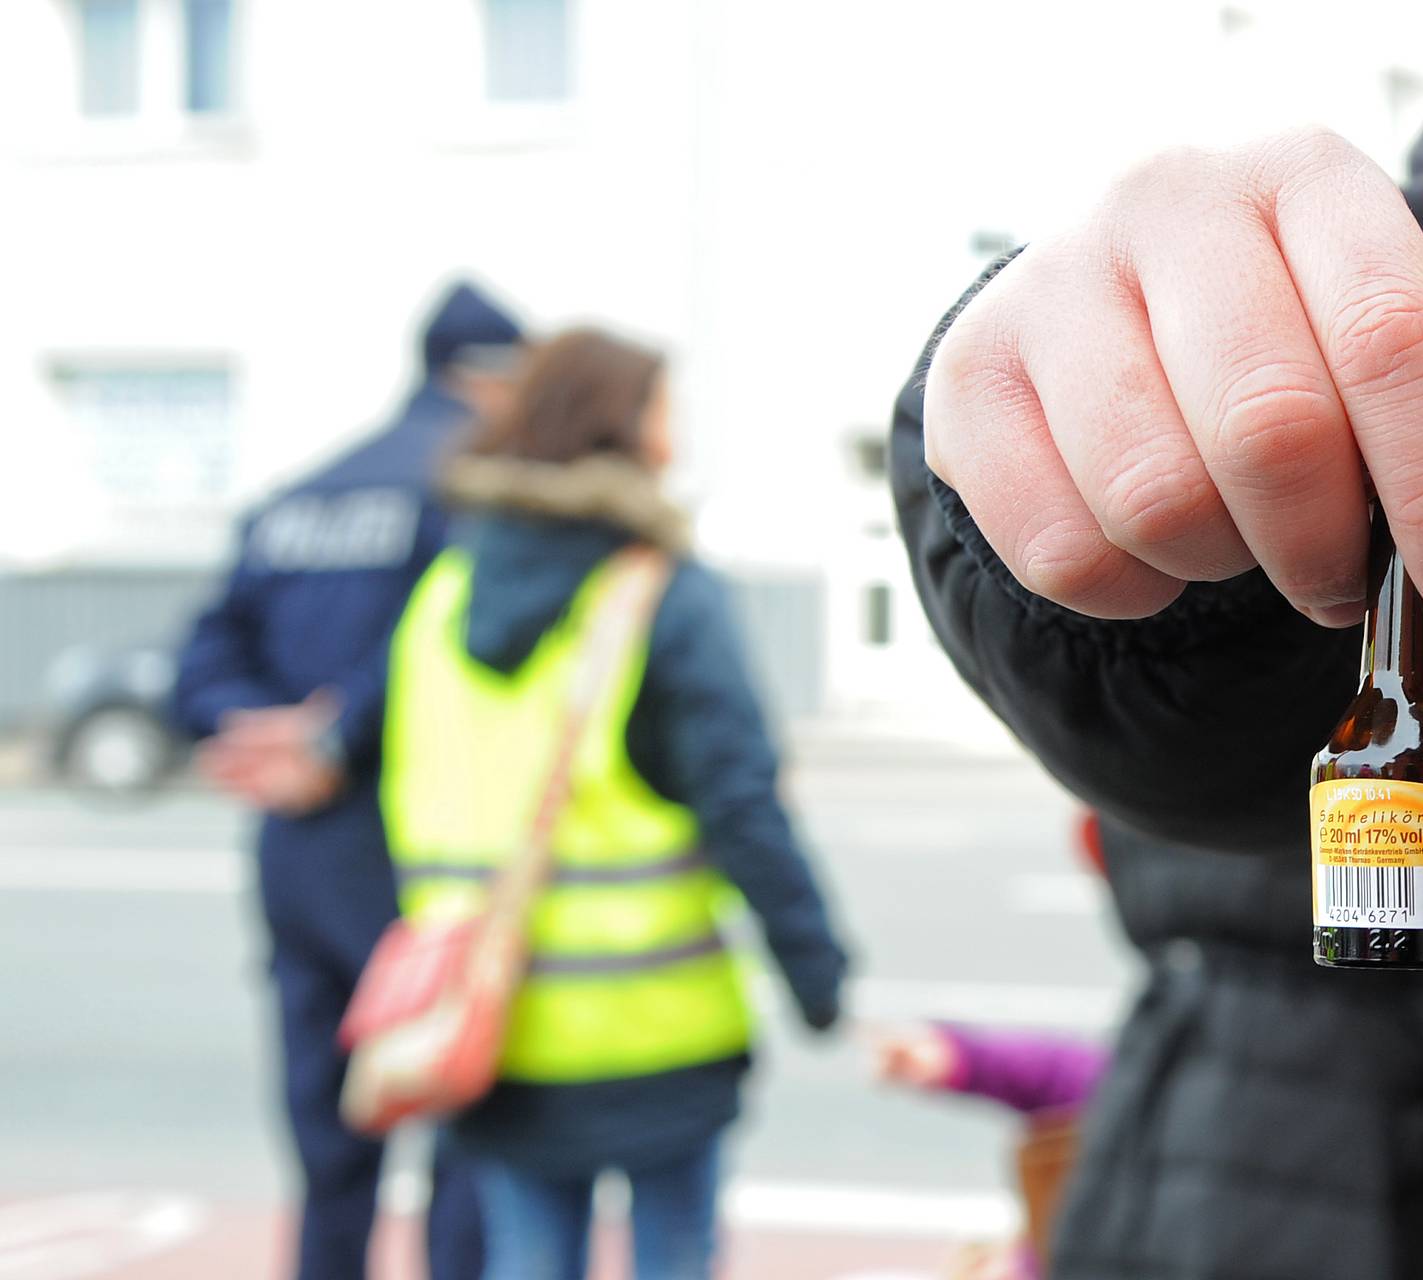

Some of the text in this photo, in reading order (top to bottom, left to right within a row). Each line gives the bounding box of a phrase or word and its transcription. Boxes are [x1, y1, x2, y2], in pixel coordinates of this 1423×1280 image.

[1366, 828, 1397, 844] 17%
[1400, 828, 1423, 843] vol
[1376, 857, 1405, 865] Germany
[1329, 908, 1408, 923] 4204 6271
